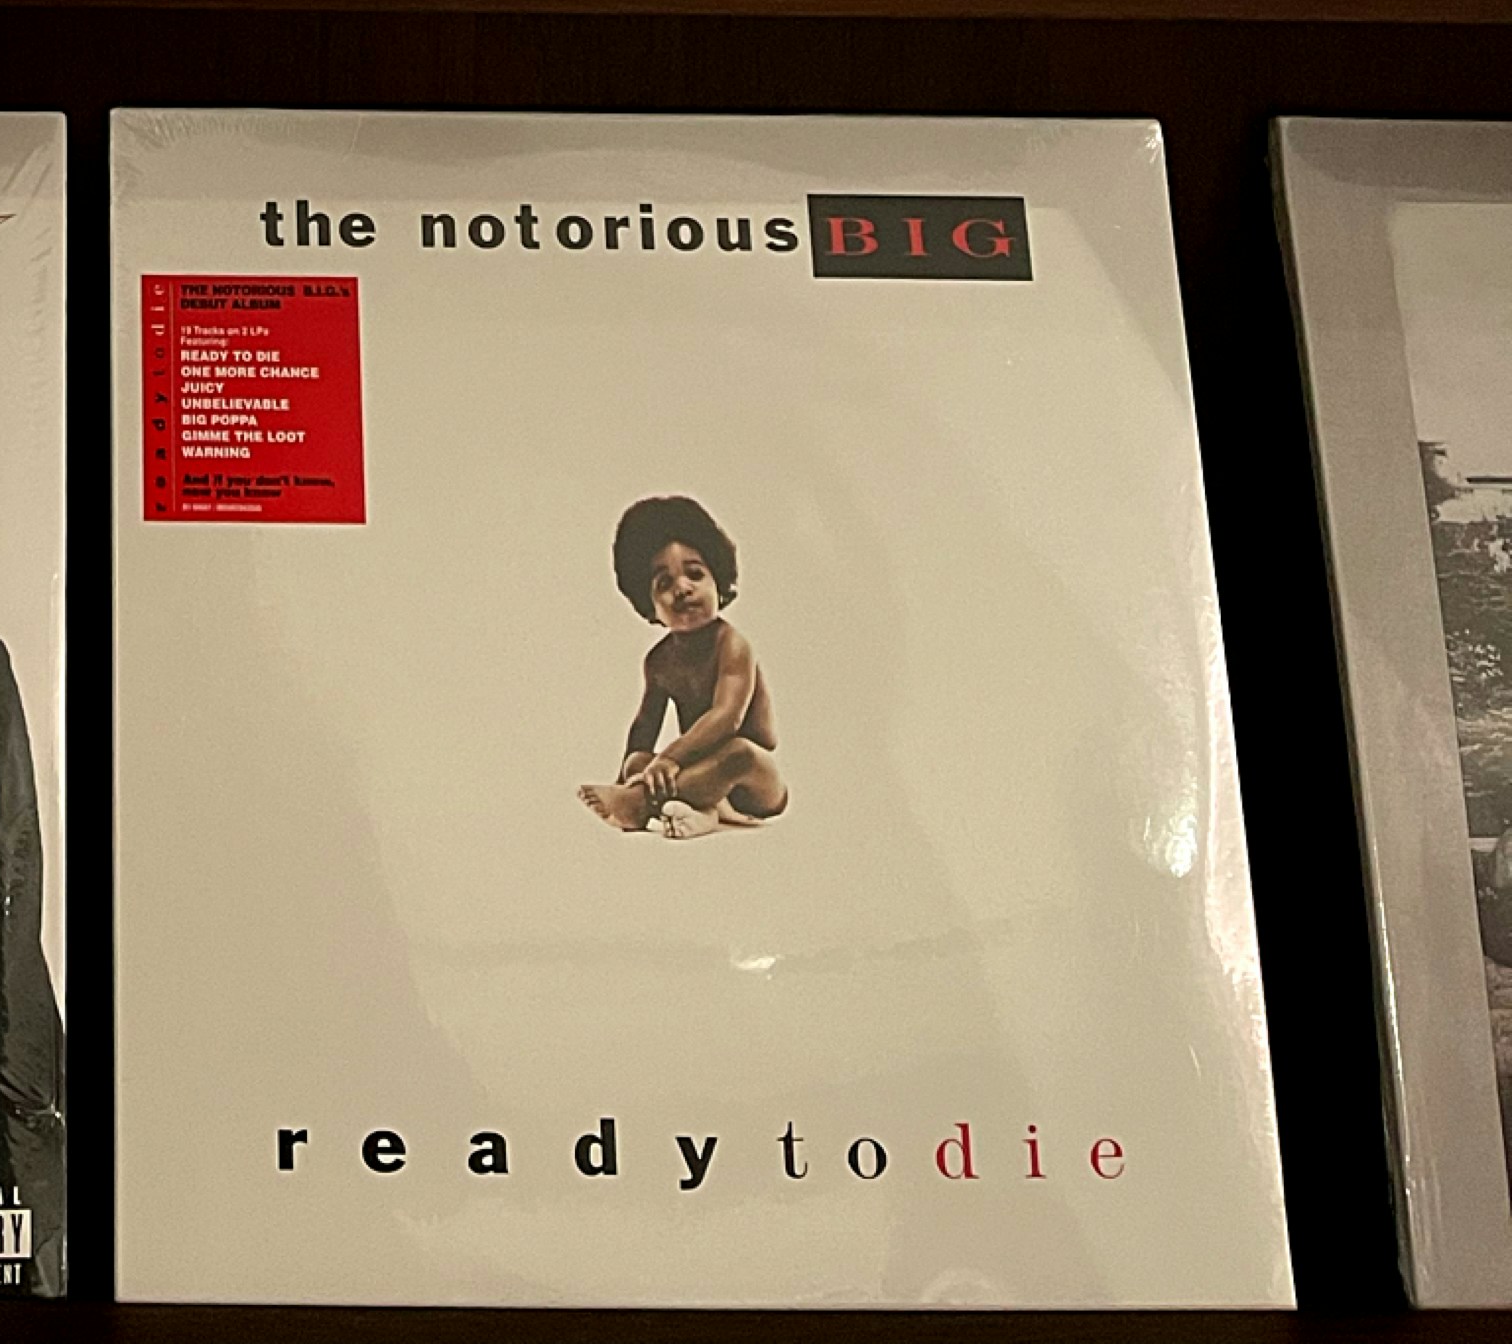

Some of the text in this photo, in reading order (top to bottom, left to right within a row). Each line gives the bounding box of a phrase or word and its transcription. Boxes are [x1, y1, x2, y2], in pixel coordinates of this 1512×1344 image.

[259, 200, 1017, 258] the notorious BIG
[180, 284, 209, 296] THE
[212, 284, 296, 297] NOTORIOUS
[180, 349, 281, 363] READY TO DIE
[180, 366, 321, 380] ONE MORE CHANCE
[180, 382, 225, 394] JUICY
[181, 398, 291, 411] UNBELIEVABLE
[181, 414, 259, 427] BIG POPPA
[181, 430, 307, 443] GIMME THE LOOT
[181, 446, 252, 459] WARNING
[276, 1118, 1128, 1191] ready to die
